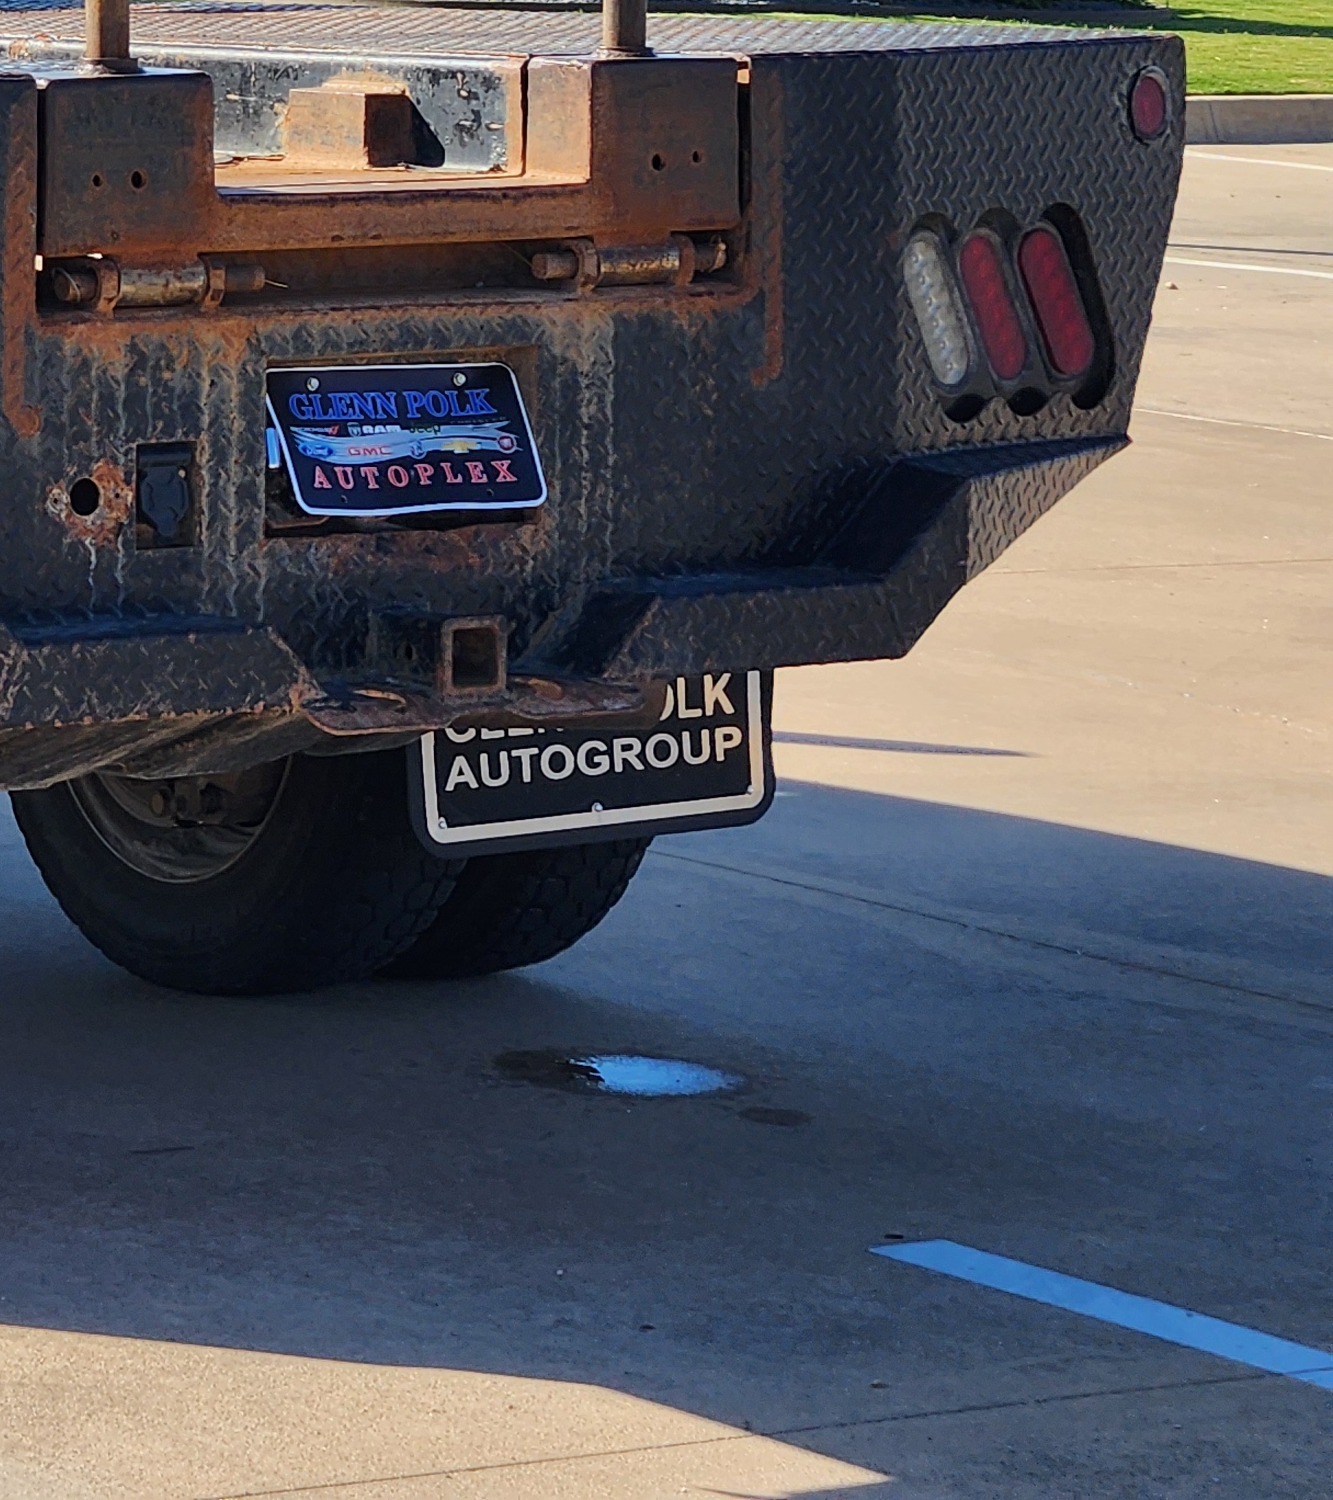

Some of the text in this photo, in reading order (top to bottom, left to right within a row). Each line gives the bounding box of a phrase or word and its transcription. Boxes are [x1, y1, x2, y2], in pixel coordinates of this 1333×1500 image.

[288, 388, 498, 421] GLENN POLK
[363, 425, 401, 434] RAM
[347, 446, 392, 456] GMC
[313, 460, 518, 490] AUTOPLEX
[659, 671, 737, 722] LK
[444, 726, 744, 791] AUTOGROUP
